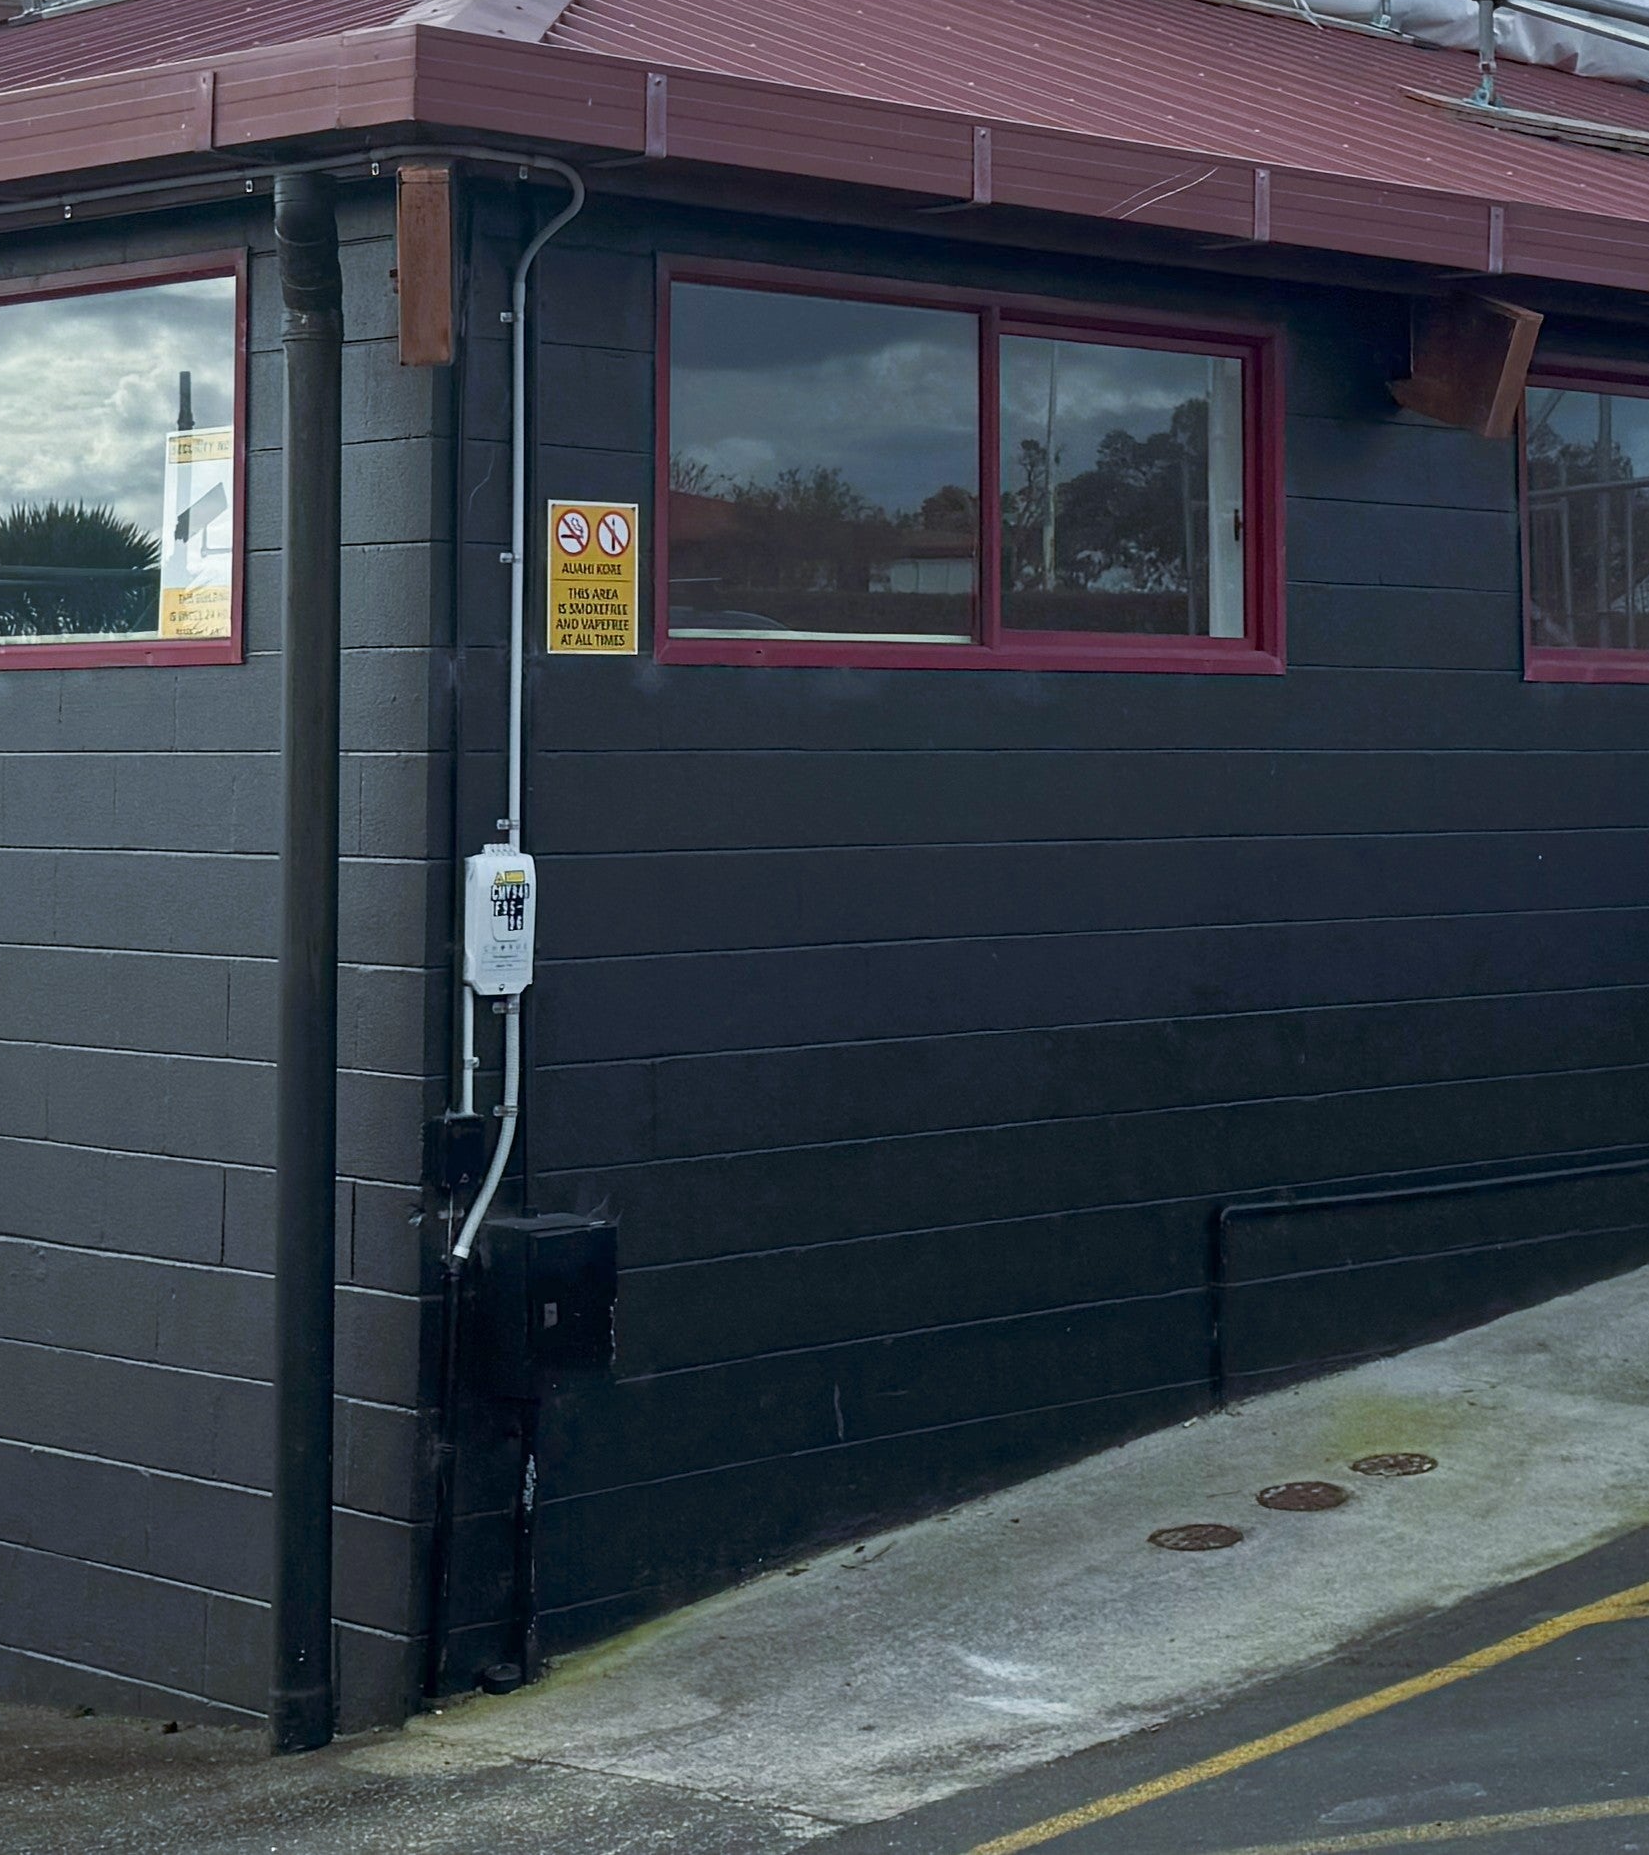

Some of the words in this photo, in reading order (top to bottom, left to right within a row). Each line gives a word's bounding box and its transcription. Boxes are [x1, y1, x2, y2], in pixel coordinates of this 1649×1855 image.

[568, 587, 590, 600] THIS
[592, 588, 619, 600] AREA
[558, 603, 567, 614] IS
[569, 603, 628, 615] SMOKEFREE
[555, 618, 579, 630] AND
[581, 618, 630, 631] VAPEFREE
[560, 634, 573, 645] AT
[575, 634, 593, 646] ALL
[595, 634, 626, 646] TIMES
